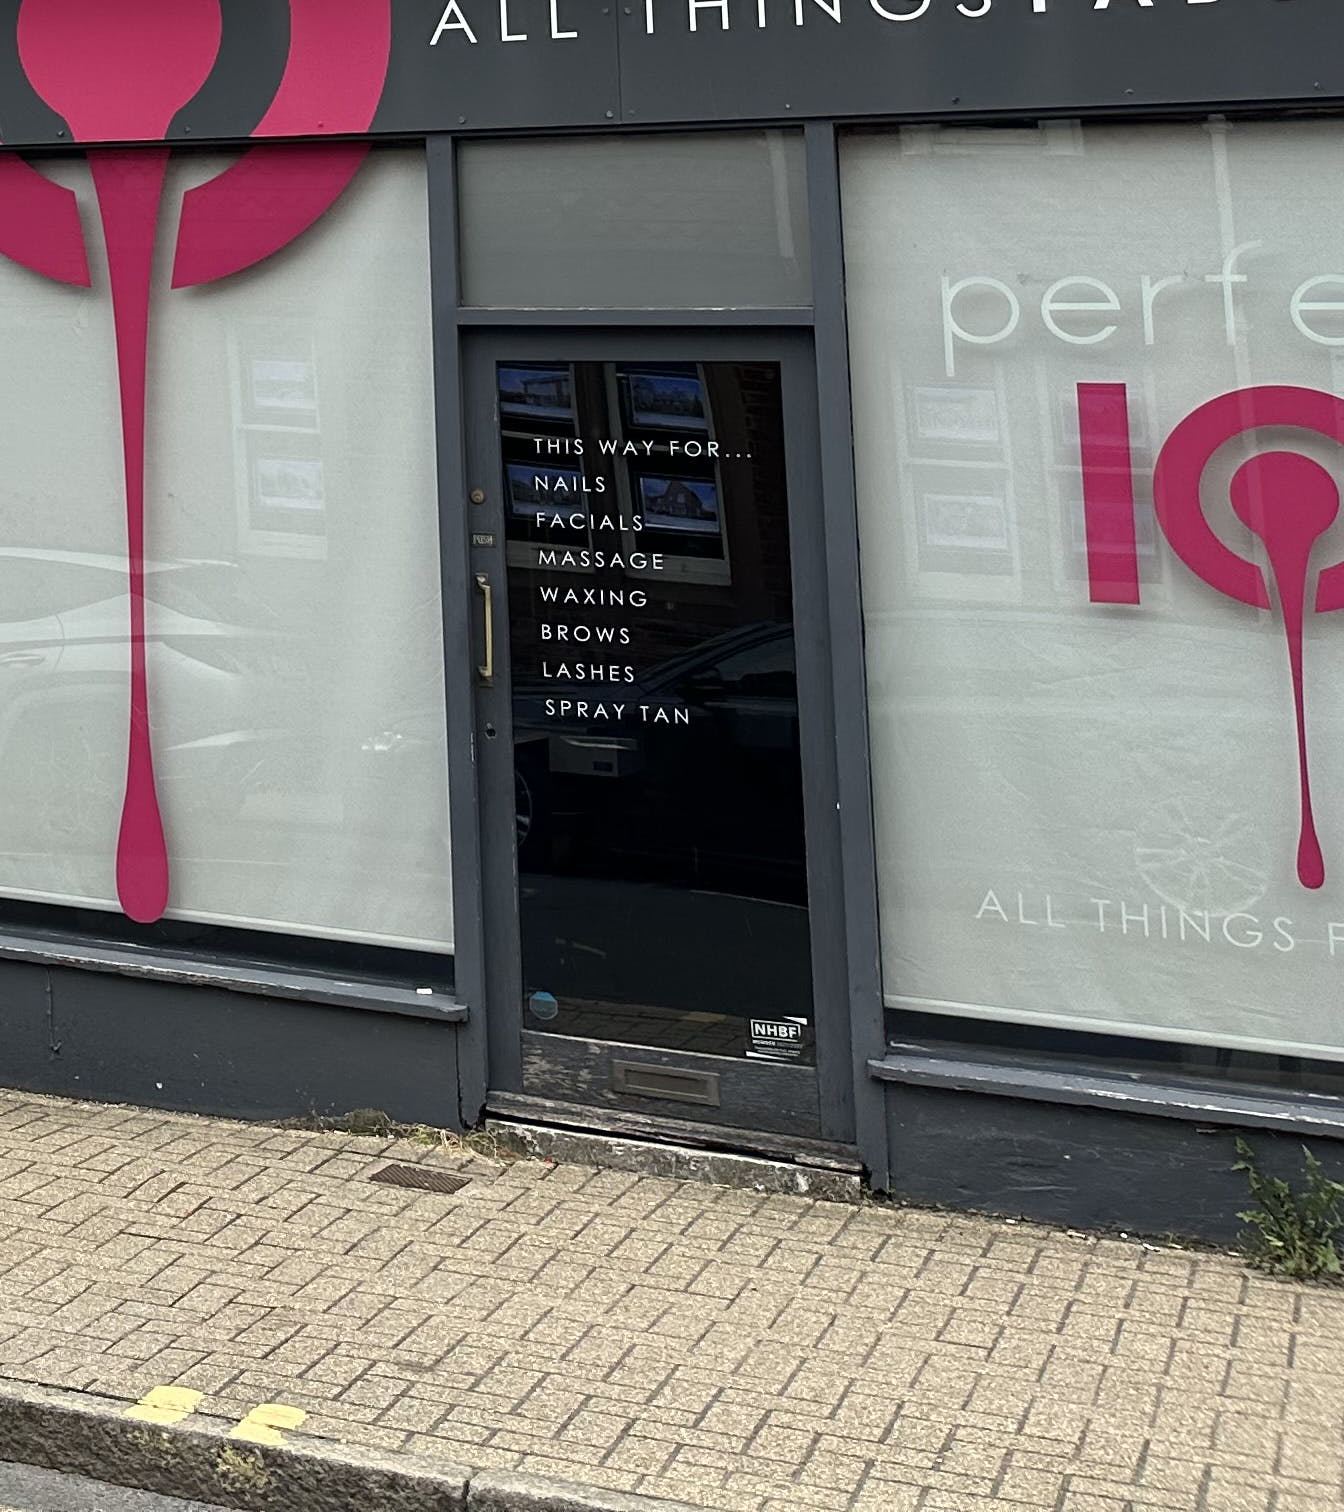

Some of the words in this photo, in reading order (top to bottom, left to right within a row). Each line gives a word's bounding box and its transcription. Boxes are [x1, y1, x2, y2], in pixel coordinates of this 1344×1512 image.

[533, 439, 584, 455] THIS
[599, 440, 654, 456] WAY
[535, 476, 606, 493] NAILS
[536, 513, 644, 531] FACIALS
[538, 550, 664, 570] MASSAGE
[540, 587, 647, 607] WAXING
[541, 624, 630, 644] BROWS
[542, 661, 635, 683] LASHES
[545, 699, 626, 720] SPRAY
[640, 705, 689, 725] TAN
[975, 888, 1066, 928] ALL
[1090, 896, 1295, 953] THINGS
[754, 1023, 797, 1038] NHBF
